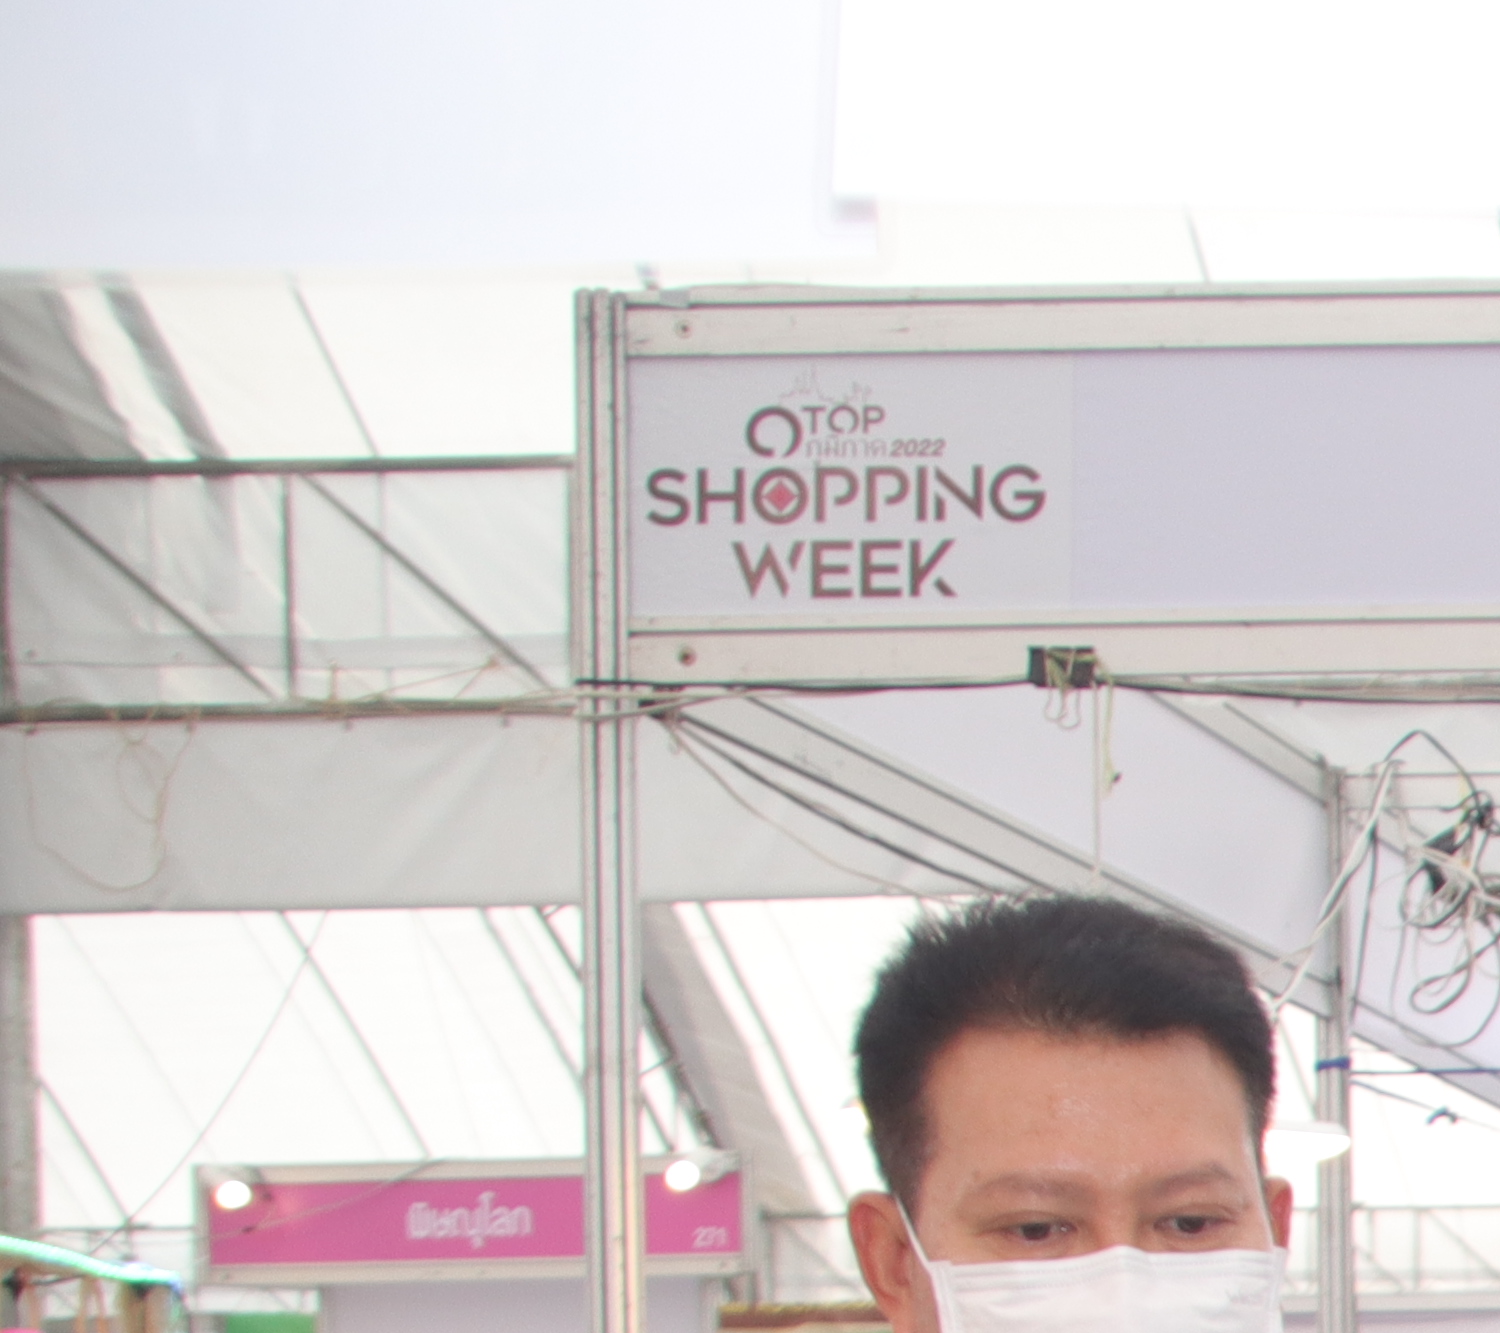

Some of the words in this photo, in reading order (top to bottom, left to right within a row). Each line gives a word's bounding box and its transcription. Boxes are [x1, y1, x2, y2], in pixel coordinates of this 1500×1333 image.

[746, 404, 886, 458] OTOP
[889, 438, 946, 457] 2022
[646, 463, 1047, 526] SHOPPING
[732, 537, 957, 599] WEEK
